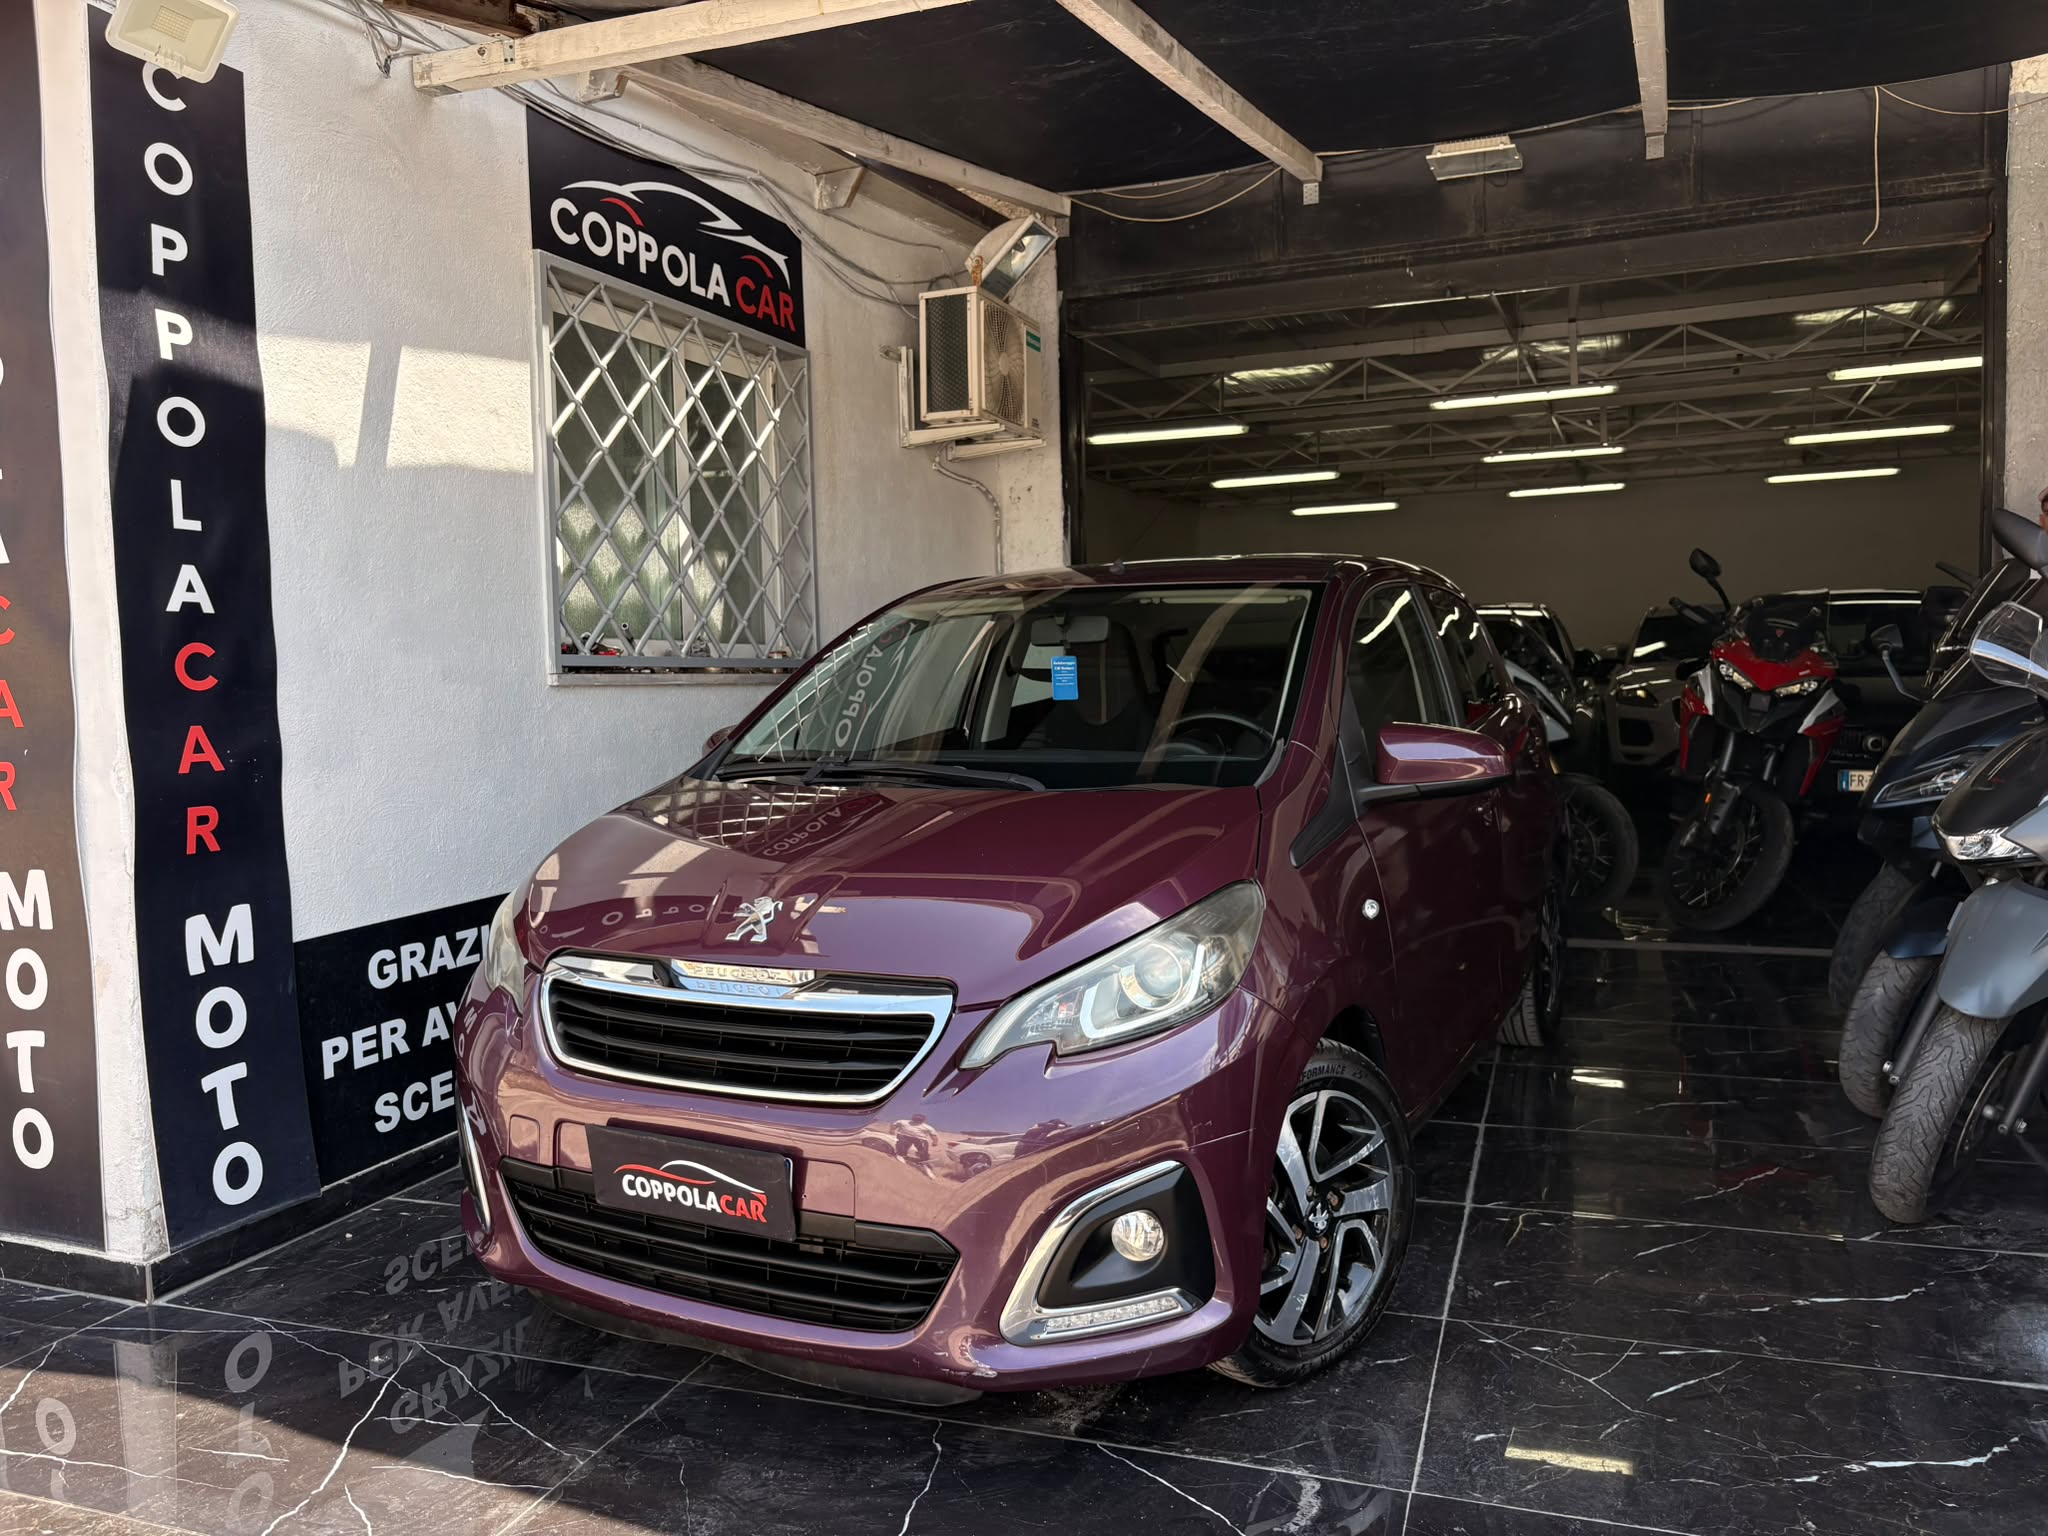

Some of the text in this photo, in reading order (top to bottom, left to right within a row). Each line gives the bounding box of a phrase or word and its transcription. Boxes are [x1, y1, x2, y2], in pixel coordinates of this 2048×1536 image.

[0, 868, 54, 1169] MOTO
[321, 1018, 410, 1080] PER
[184, 903, 264, 1206] MOTO
[1300, 1063, 1346, 1081] FORMANCE
[374, 1070, 455, 1133] SCE
